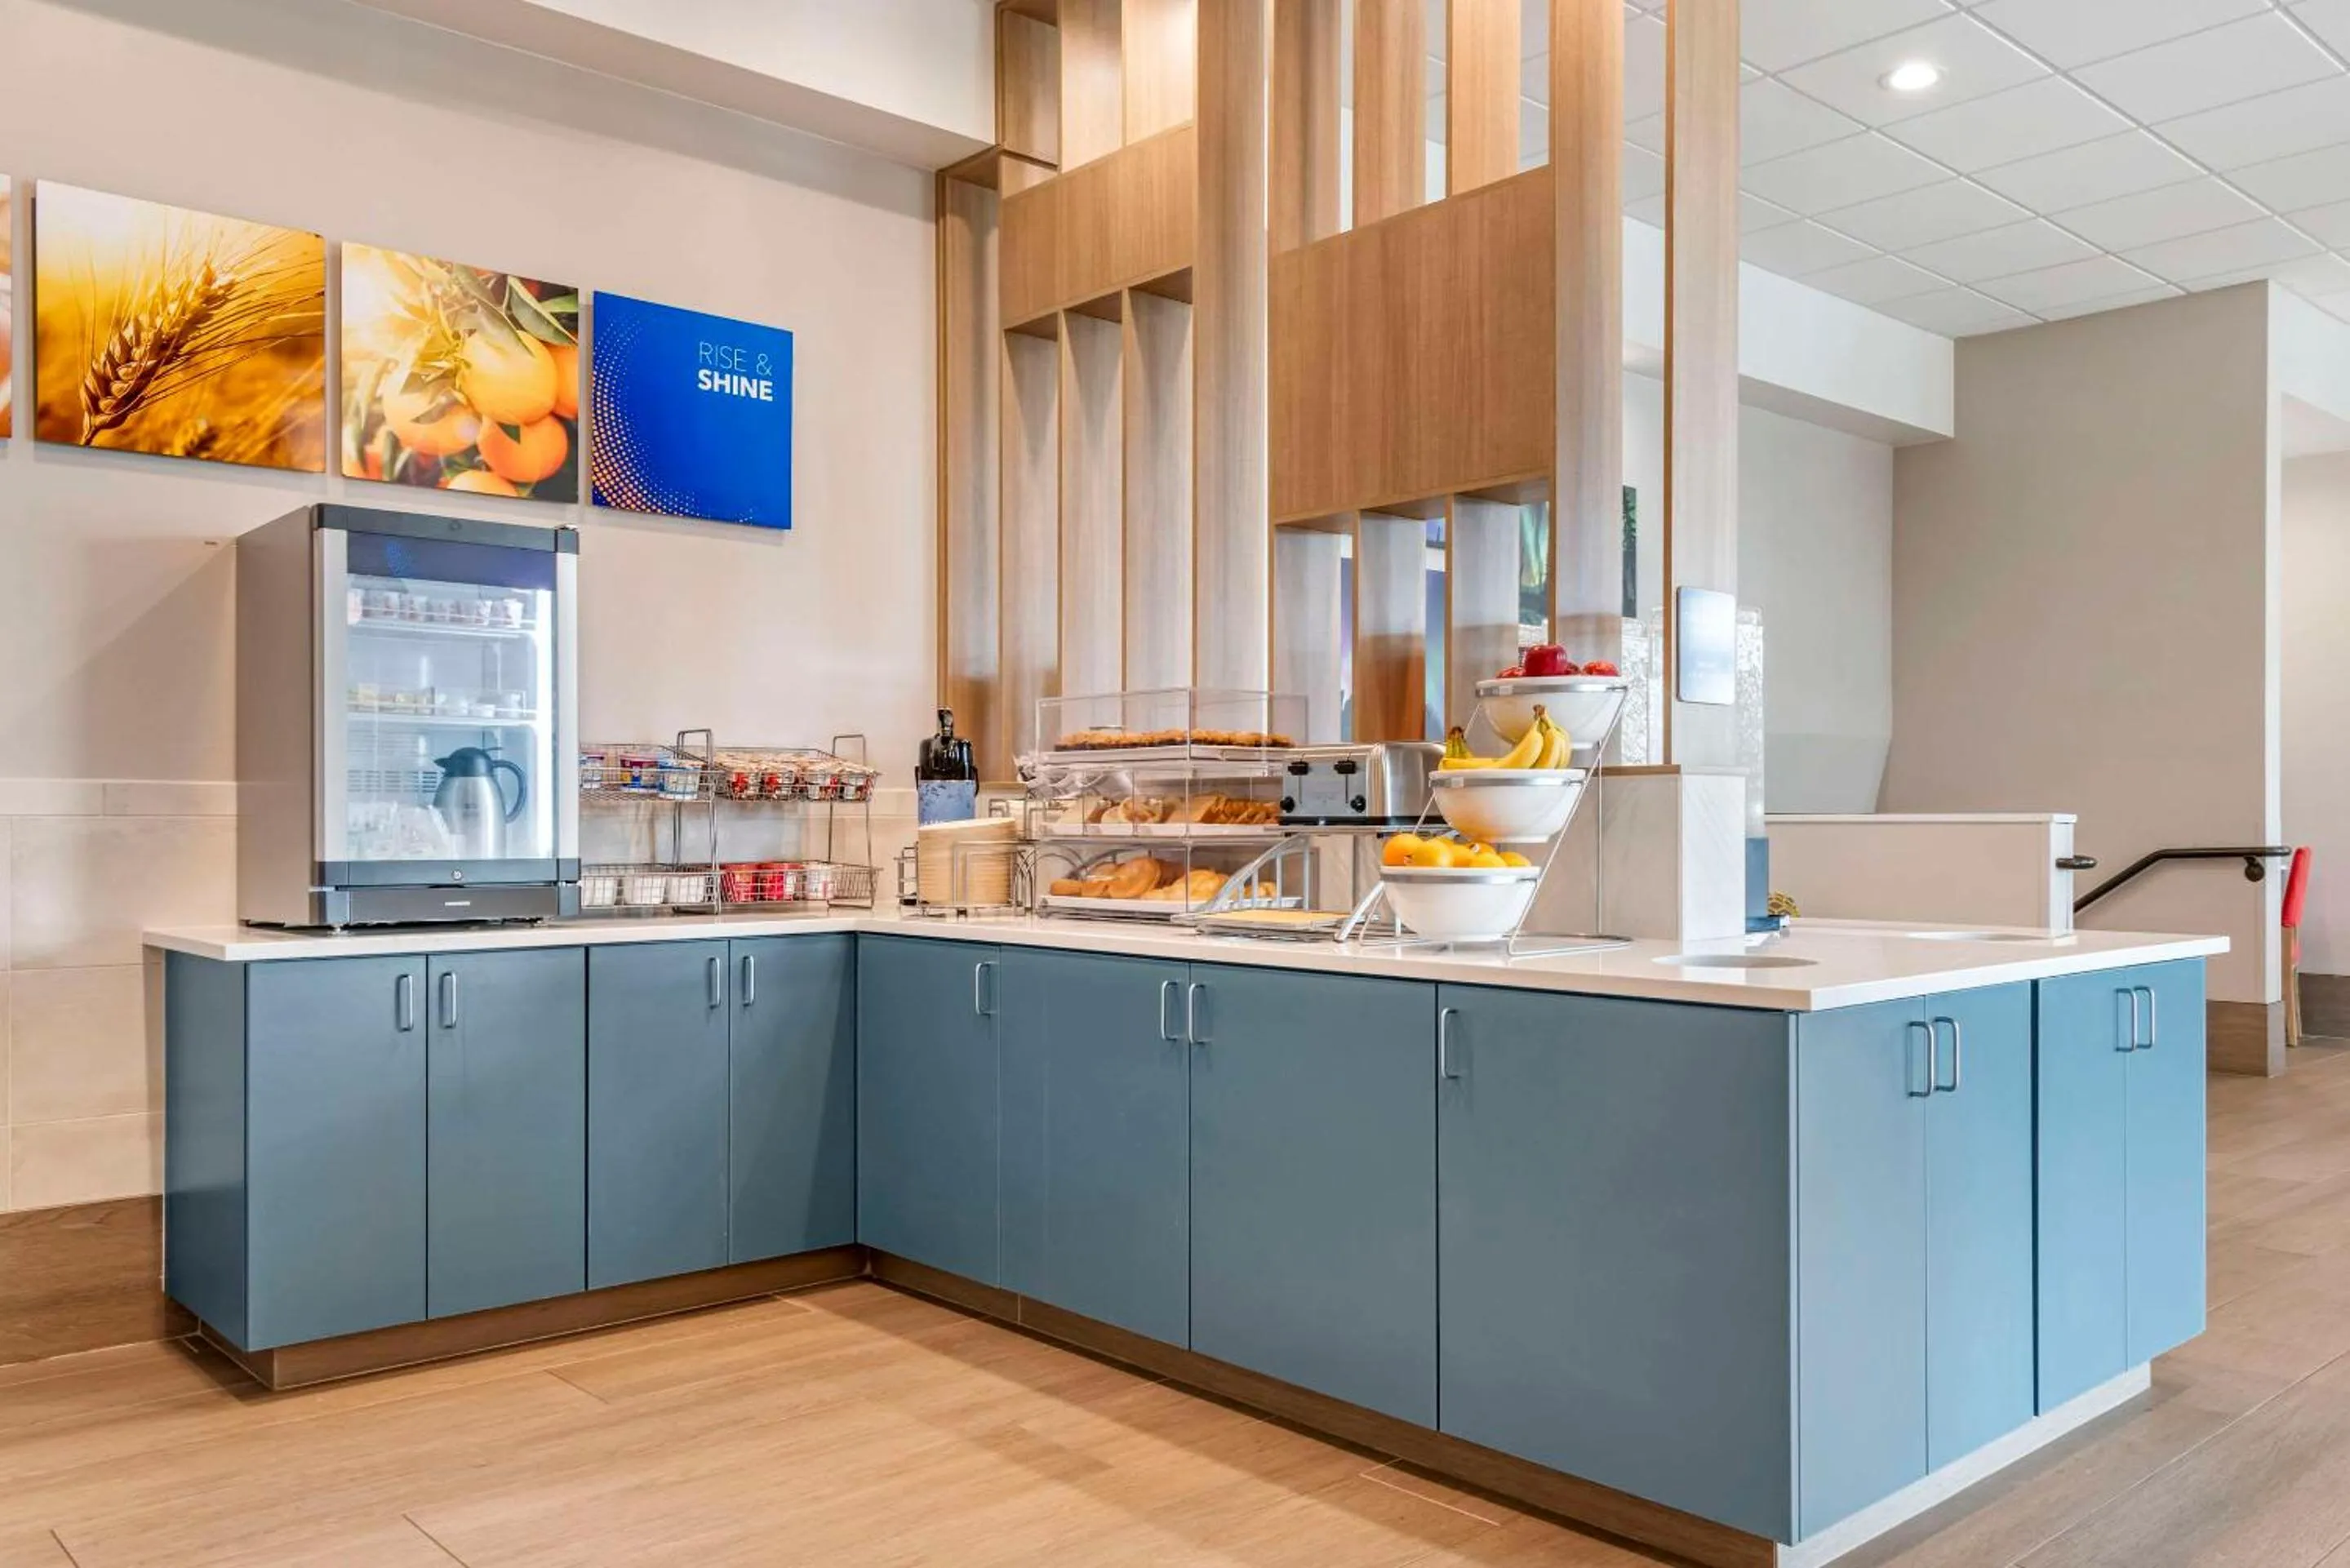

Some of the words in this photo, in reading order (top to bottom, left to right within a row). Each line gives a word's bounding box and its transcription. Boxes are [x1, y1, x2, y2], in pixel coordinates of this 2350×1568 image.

[700, 341, 747, 372] RISE
[756, 353, 773, 376] &
[698, 369, 774, 402] SHINE
